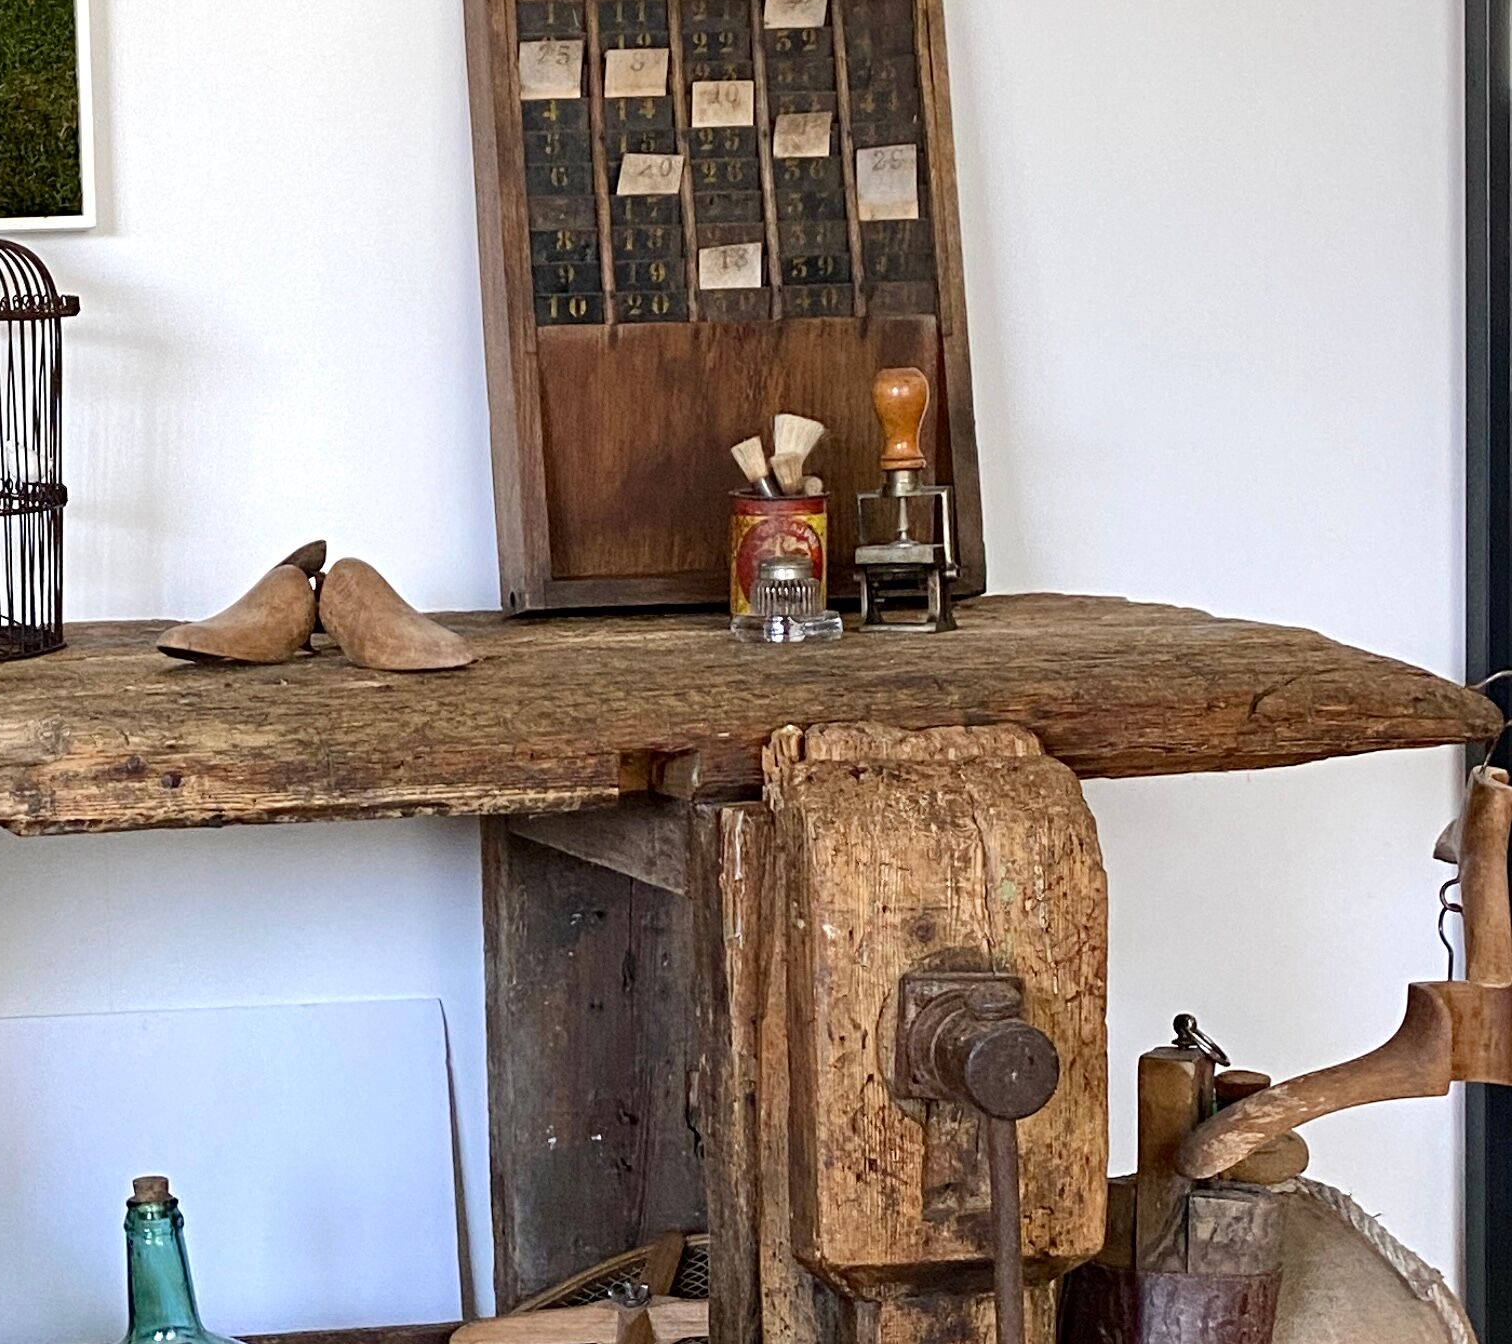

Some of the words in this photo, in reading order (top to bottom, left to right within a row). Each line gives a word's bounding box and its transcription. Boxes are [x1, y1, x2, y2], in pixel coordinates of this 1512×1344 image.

[692, 32, 734, 54] 22
[618, 98, 656, 121] 14
[550, 166, 568, 187] 6
[556, 228, 573, 252] 8
[559, 263, 575, 284] 9
[629, 261, 666, 284] 19
[548, 293, 587, 319] 10
[627, 293, 671, 316] 20
